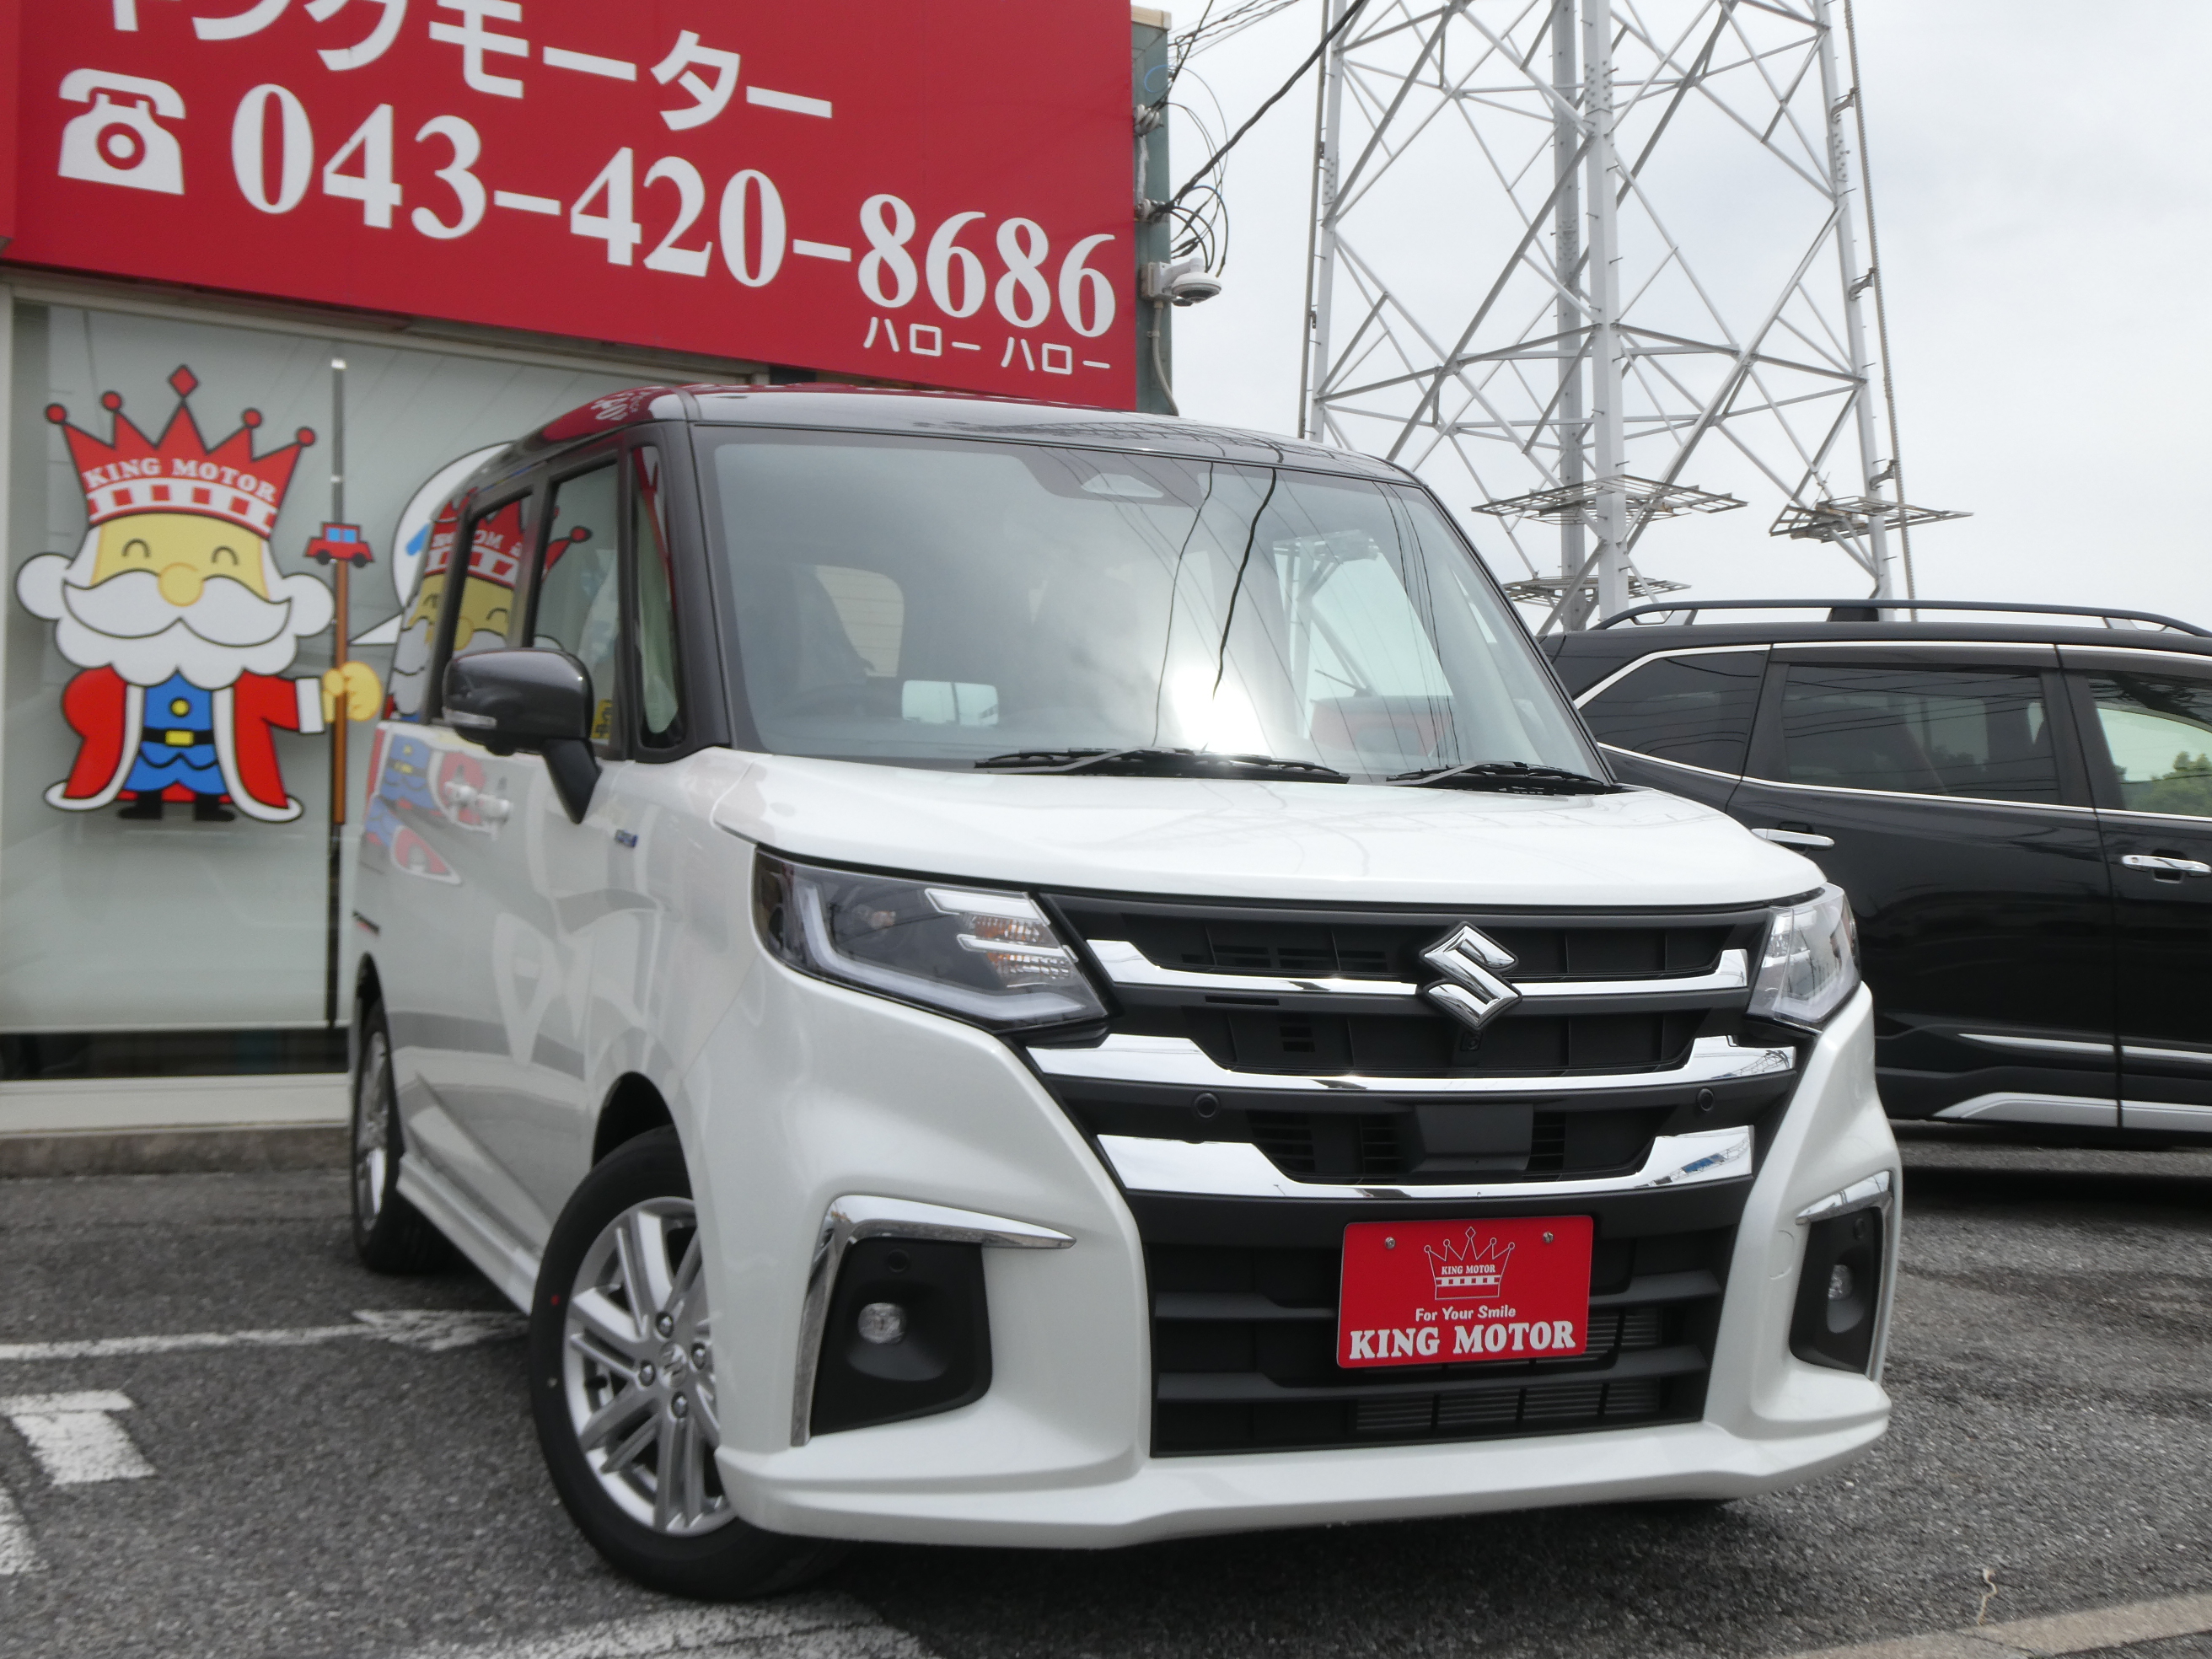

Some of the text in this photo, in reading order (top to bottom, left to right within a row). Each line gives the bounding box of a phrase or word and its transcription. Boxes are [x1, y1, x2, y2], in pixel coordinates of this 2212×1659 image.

[111, 0, 833, 132] グモーター
[231, 83, 1116, 338] 043-420-8686
[862, 316, 1111, 375] ハロー ハロー
[83, 457, 276, 503] KING MOTOR
[1441, 1264, 1496, 1275] KING MOTOR
[1415, 1304, 1517, 1322] For Your Smile
[1349, 1320, 1576, 1360] KING MOTOR
